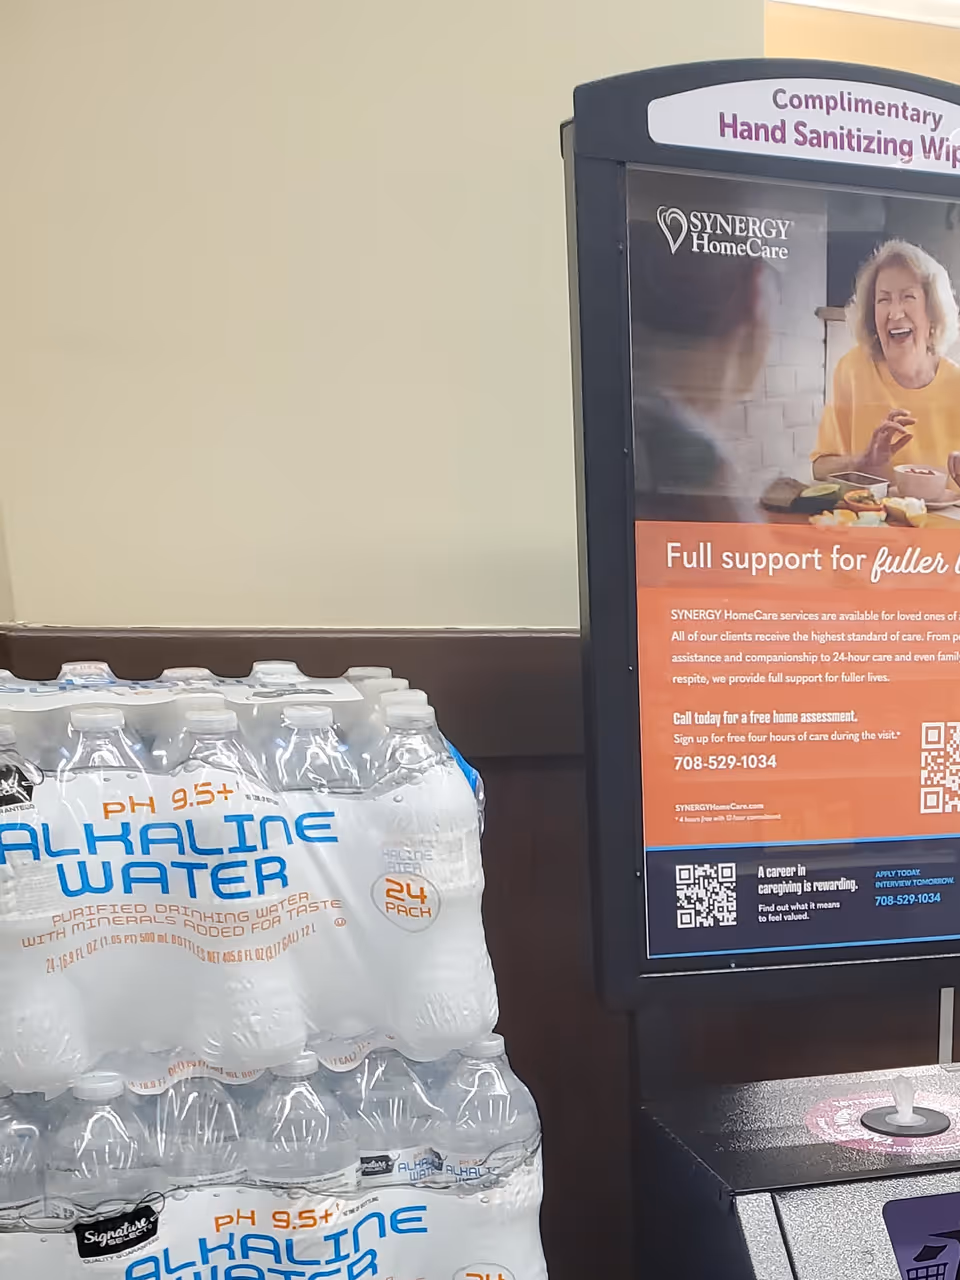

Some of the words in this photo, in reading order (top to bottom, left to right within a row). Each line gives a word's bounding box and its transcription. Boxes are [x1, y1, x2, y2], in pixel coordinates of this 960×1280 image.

[772, 88, 943, 131] Complimentary
[719, 112, 786, 143] Hand
[794, 121, 913, 164] Sanitizing
[689, 210, 790, 239] SYNERGY
[690, 233, 788, 259] HomeCare
[666, 542, 712, 568] Full
[721, 548, 822, 576] support
[830, 545, 867, 571] for
[871, 547, 949, 583] fuller
[671, 610, 721, 620] SYNERGY
[724, 610, 778, 621] HomeCare
[780, 611, 819, 621] services
[821, 613, 837, 621] are
[839, 611, 879, 621] available
[881, 611, 895, 621] for
[897, 611, 922, 621] loved
[924, 613, 945, 622] ones
[947, 611, 957, 622] of
[671, 631, 685, 641] All
[687, 631, 699, 641] of
[700, 633, 718, 642] our
[720, 631, 752, 642] clients
[755, 632, 790, 642] receive
[793, 631, 808, 641] the
[811, 631, 845, 643] highest
[847, 632, 887, 642] standard
[890, 631, 900, 641] of
[902, 633, 924, 642] care.
[927, 631, 950, 641] From
[671, 652, 722, 662] assistance
[724, 652, 742, 662] and
[745, 652, 818, 664] companionship
[820, 653, 831, 662] to
[833, 652, 870, 662] 24-hour
[872, 653, 892, 662] care
[894, 652, 912, 662] and
[914, 653, 936, 662] even
[673, 711, 692, 725] Call
[694, 711, 721, 727] today
[723, 710, 739, 725] for
[741, 713, 748, 724] a
[749, 710, 771, 724] free
[773, 710, 798, 723] home
[800, 710, 858, 723] assessment.
[674, 733, 694, 745] Sign
[696, 734, 709, 745] up
[711, 733, 724, 743] for
[727, 732, 746, 743] free
[748, 732, 767, 743] four
[769, 732, 796, 742] hours
[797, 731, 808, 742] of
[809, 732, 829, 741] care
[831, 730, 859, 743] during
[861, 730, 876, 740] the
[673, 754, 777, 770] 708-529-1034
[675, 802, 764, 812] SYNERGYHomeCare.com
[0, 811, 338, 865] ALKALINE
[56, 855, 289, 900] WATER
[758, 865, 765, 878] A
[766, 865, 797, 878] career
[797, 863, 806, 876] in
[385, 877, 427, 905] 24
[758, 880, 802, 896] caregiving
[803, 879, 812, 892] is
[813, 877, 858, 893] rewarding.
[52, 903, 147, 927] PURIFIED
[154, 903, 250, 925] DRINKING
[255, 891, 310, 919] WATER
[385, 901, 431, 918] PACK
[875, 892, 941, 907] 708-529-1034
[83, 1214, 150, 1249] Signature
[107, 1226, 150, 1247] SELECT
